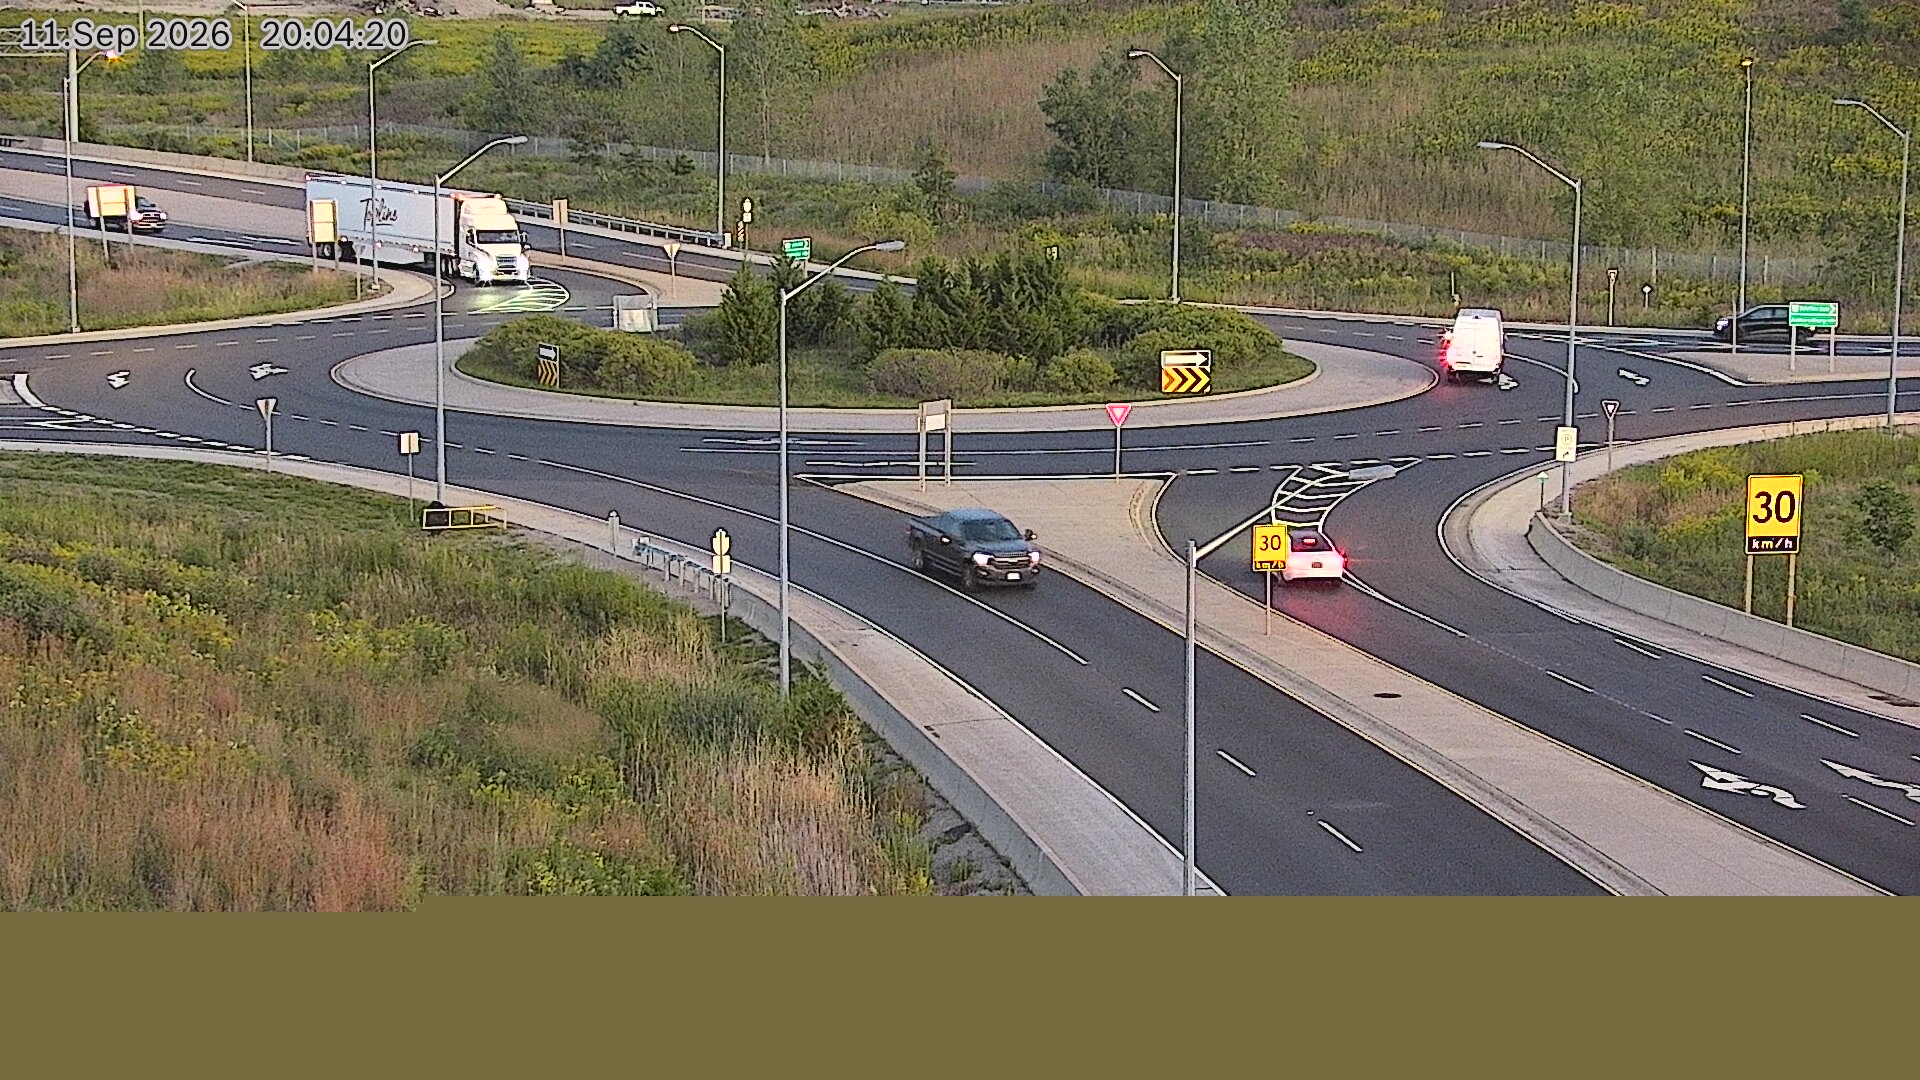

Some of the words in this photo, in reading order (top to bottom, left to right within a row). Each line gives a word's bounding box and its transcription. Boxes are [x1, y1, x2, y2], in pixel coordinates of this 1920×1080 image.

[1752, 490, 1796, 524] 30
[1259, 534, 1282, 552] 30
[1751, 537, 1793, 550] km/h
